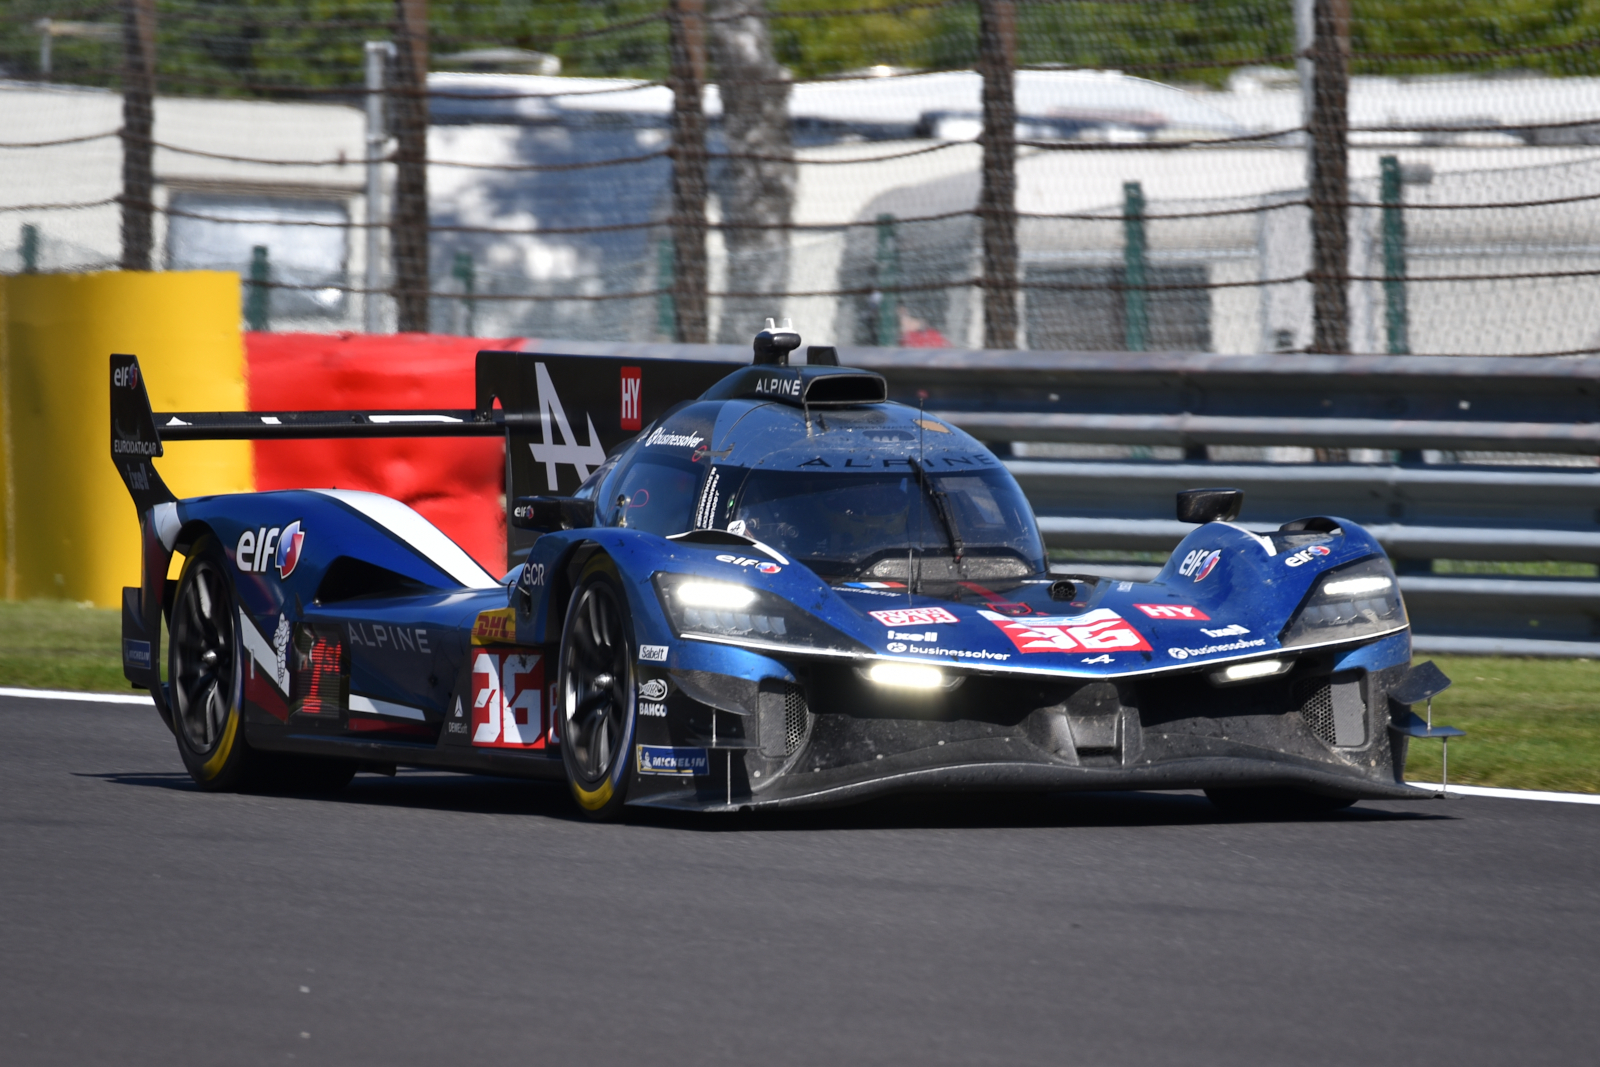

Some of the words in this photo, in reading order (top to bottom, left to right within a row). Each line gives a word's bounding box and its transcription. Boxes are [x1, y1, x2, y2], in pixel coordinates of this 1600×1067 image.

[114, 366, 129, 387] elf
[755, 378, 801, 396] ALPINE
[621, 378, 640, 420] HY
[652, 428, 704, 448] businessolver
[114, 440, 157, 455] EURODATACAR
[796, 453, 996, 468] ALPINE
[127, 463, 150, 490] ixell
[514, 506, 527, 517] elf
[236, 527, 280, 572] elf
[1285, 549, 1314, 567] elf
[715, 554, 759, 567] elf
[1179, 549, 1210, 577] elf
[523, 563, 545, 586] GCR
[883, 613, 951, 624] CAR
[1140, 605, 1196, 617] HY
[477, 615, 510, 638] DHL
[1003, 621, 1141, 649] 36
[347, 623, 432, 653] ALPINE
[1184, 637, 1267, 656] businessolver
[641, 646, 665, 660] Sabelt
[909, 644, 1011, 661] businessolver
[472, 653, 542, 744] 36
[639, 703, 668, 717] BAHCO
[652, 756, 706, 768] MICHELIN
